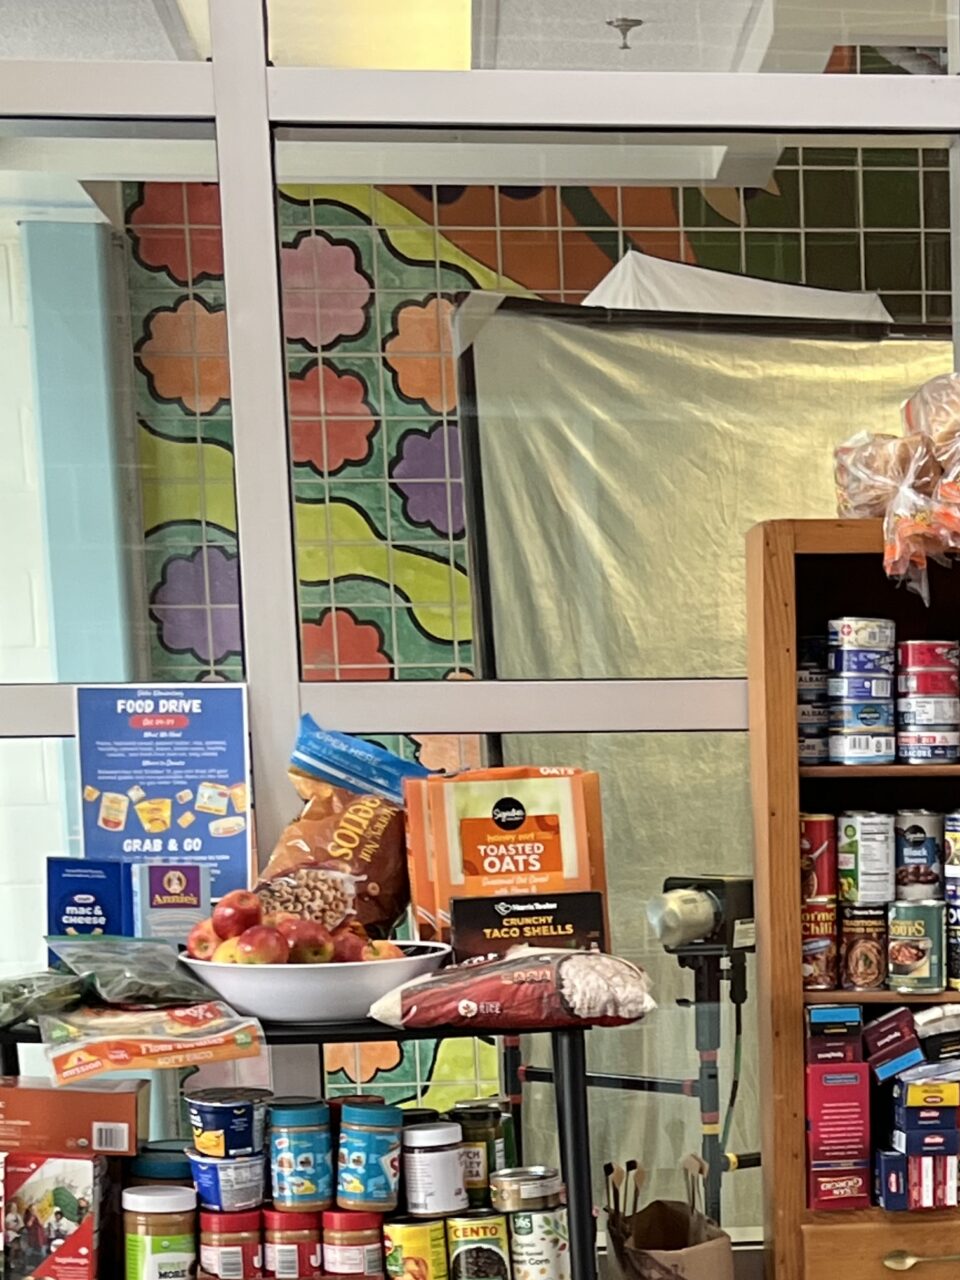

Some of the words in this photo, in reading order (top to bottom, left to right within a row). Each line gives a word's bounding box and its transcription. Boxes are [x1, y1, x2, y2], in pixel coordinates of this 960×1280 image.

[117, 700, 154, 714] FOOD
[159, 700, 202, 714] DRIVE
[123, 839, 163, 852] GRAB
[167, 839, 178, 851] &
[183, 838, 202, 852] GO
[477, 843, 544, 857] TOASTED
[483, 855, 541, 873] OATS
[153, 893, 198, 906] Annie's
[65, 906, 92, 916] mac
[93, 905, 103, 916] &
[503, 916, 553, 926] CRUNCHY
[483, 927, 520, 939] TACO
[523, 924, 574, 938] SHELLS
[801, 921, 832, 935] Chili
[514, 1217, 531, 1229] 365
[453, 1226, 499, 1237] CENTO
[158, 1269, 187, 1280] MORE
